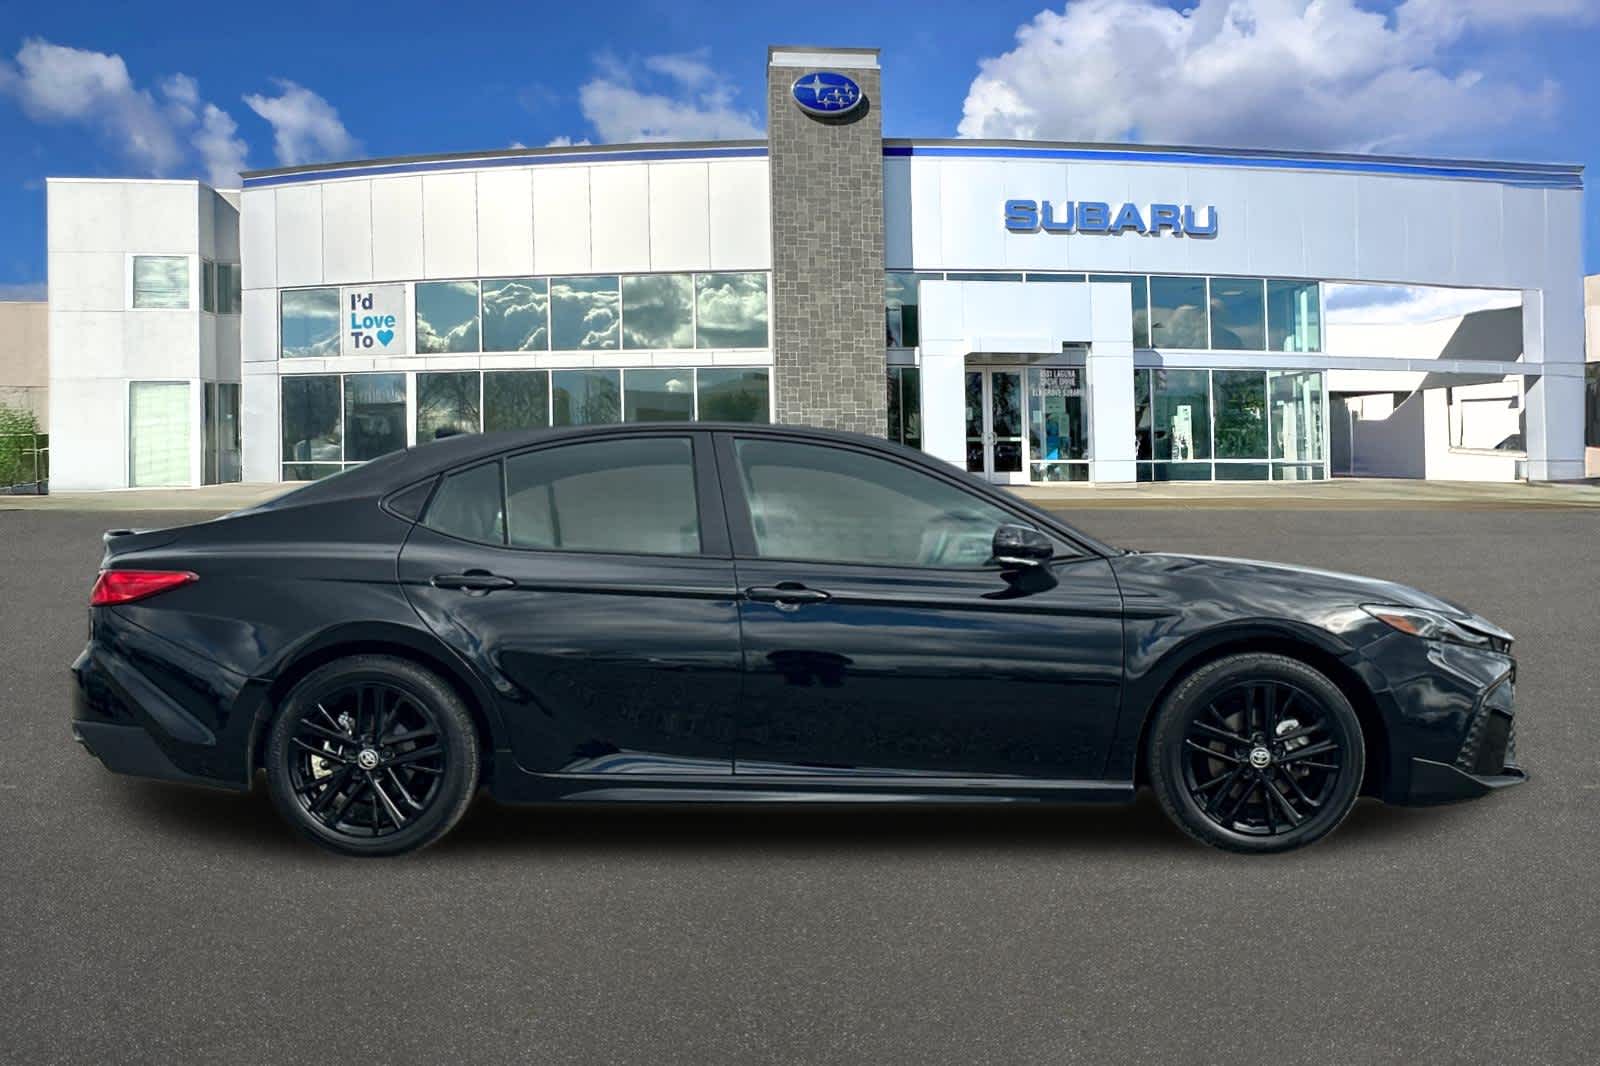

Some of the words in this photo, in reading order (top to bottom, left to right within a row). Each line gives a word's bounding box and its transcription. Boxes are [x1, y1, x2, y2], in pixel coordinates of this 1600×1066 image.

[1004, 199, 1218, 239] SUBARU
[350, 293, 373, 311] I'd
[351, 313, 396, 330] Love
[350, 331, 374, 349] To
